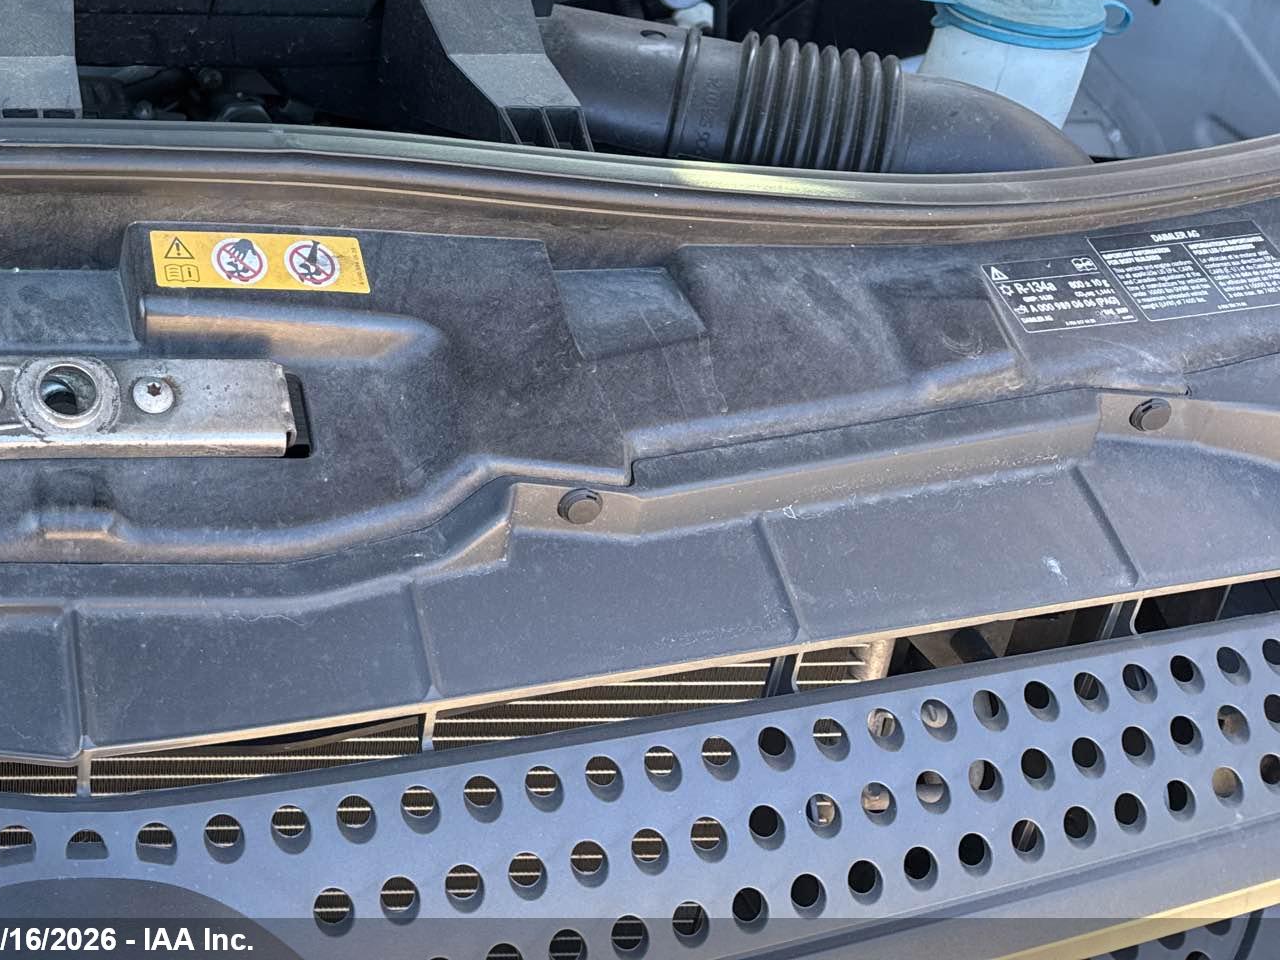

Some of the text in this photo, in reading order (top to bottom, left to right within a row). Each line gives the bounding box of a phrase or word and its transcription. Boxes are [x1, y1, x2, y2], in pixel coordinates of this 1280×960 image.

[1150, 229, 1201, 243] DAIMLER AG
[1013, 281, 1057, 294] R-134a
[1091, 279, 1103, 288] 10
[1029, 304, 1038, 314] A
[1037, 303, 1055, 312] 000
[1070, 300, 1084, 309] 06
[1083, 299, 1097, 308] 06
[1095, 296, 1121, 307] (PAG)
